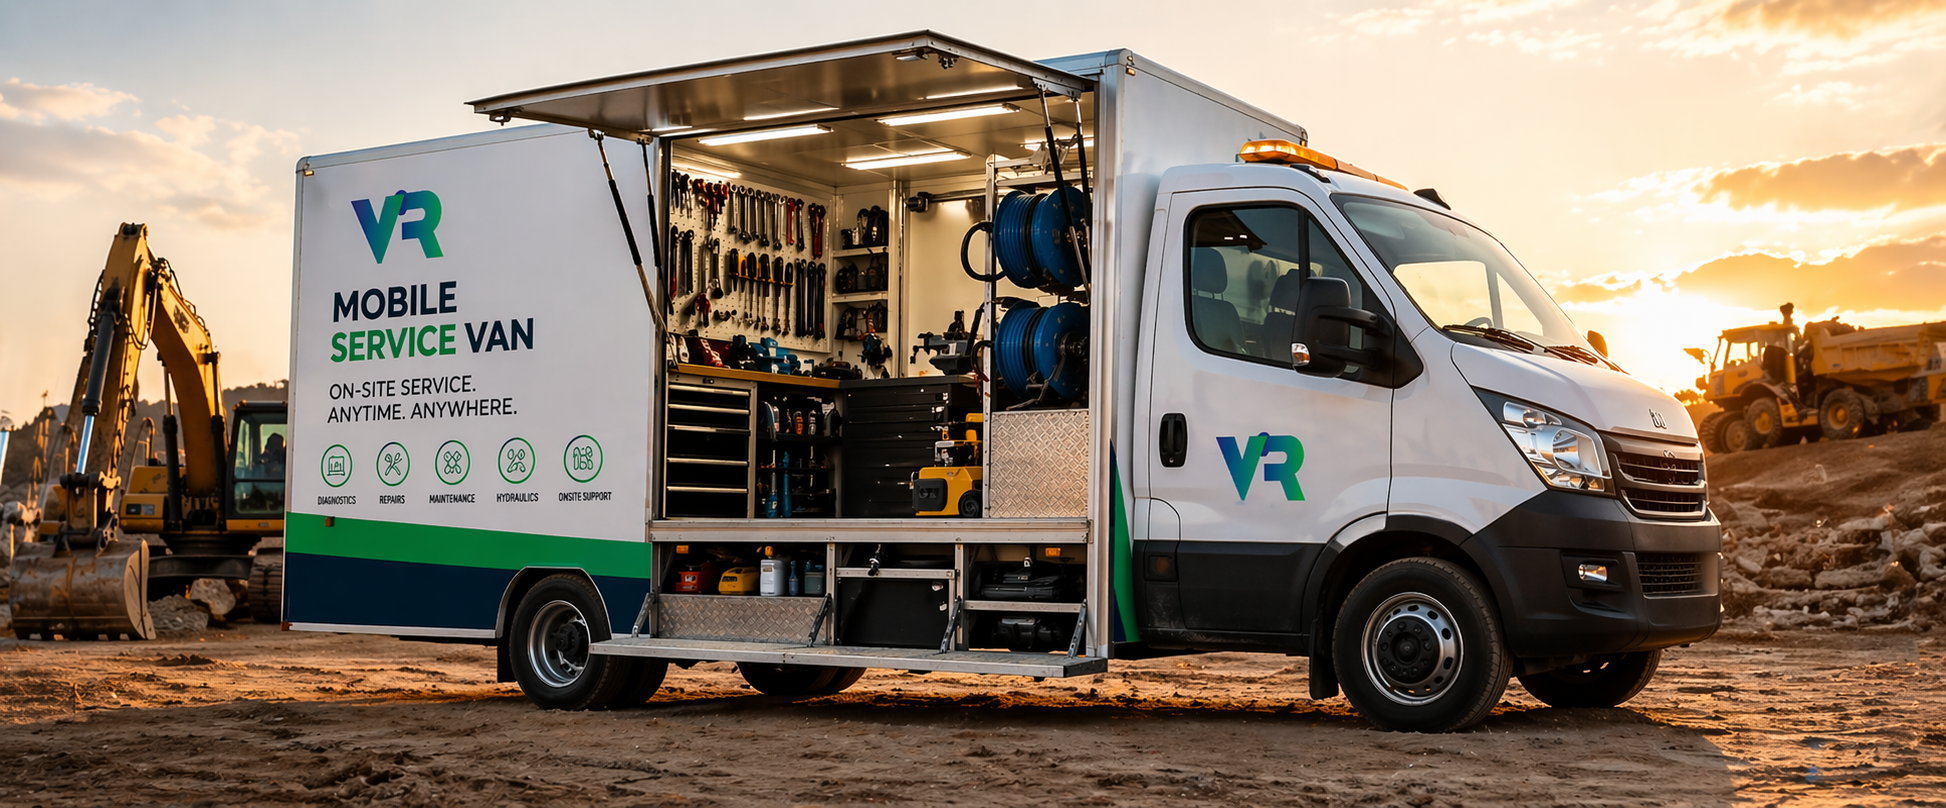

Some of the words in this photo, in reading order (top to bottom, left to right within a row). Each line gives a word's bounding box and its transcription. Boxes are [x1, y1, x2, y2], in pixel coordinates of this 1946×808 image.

[351, 189, 443, 264] VR
[333, 281, 457, 322] MOBILE
[330, 324, 456, 362] SERVICE
[464, 318, 533, 353] VAN
[329, 380, 395, 400] ON-SITE
[400, 375, 476, 396] SERVICE.
[327, 403, 405, 423] ANYTIME.
[410, 398, 517, 419] ANYWHERE.
[1216, 431, 1305, 501] VR
[317, 495, 356, 505] DIAGNOSTICS
[379, 495, 405, 504] REPAIRS
[429, 493, 475, 504] MAINTENANCE
[496, 492, 539, 503] HYDRAULICS
[558, 492, 581, 502] ONSITE
[583, 491, 612, 501] SUPPORT
